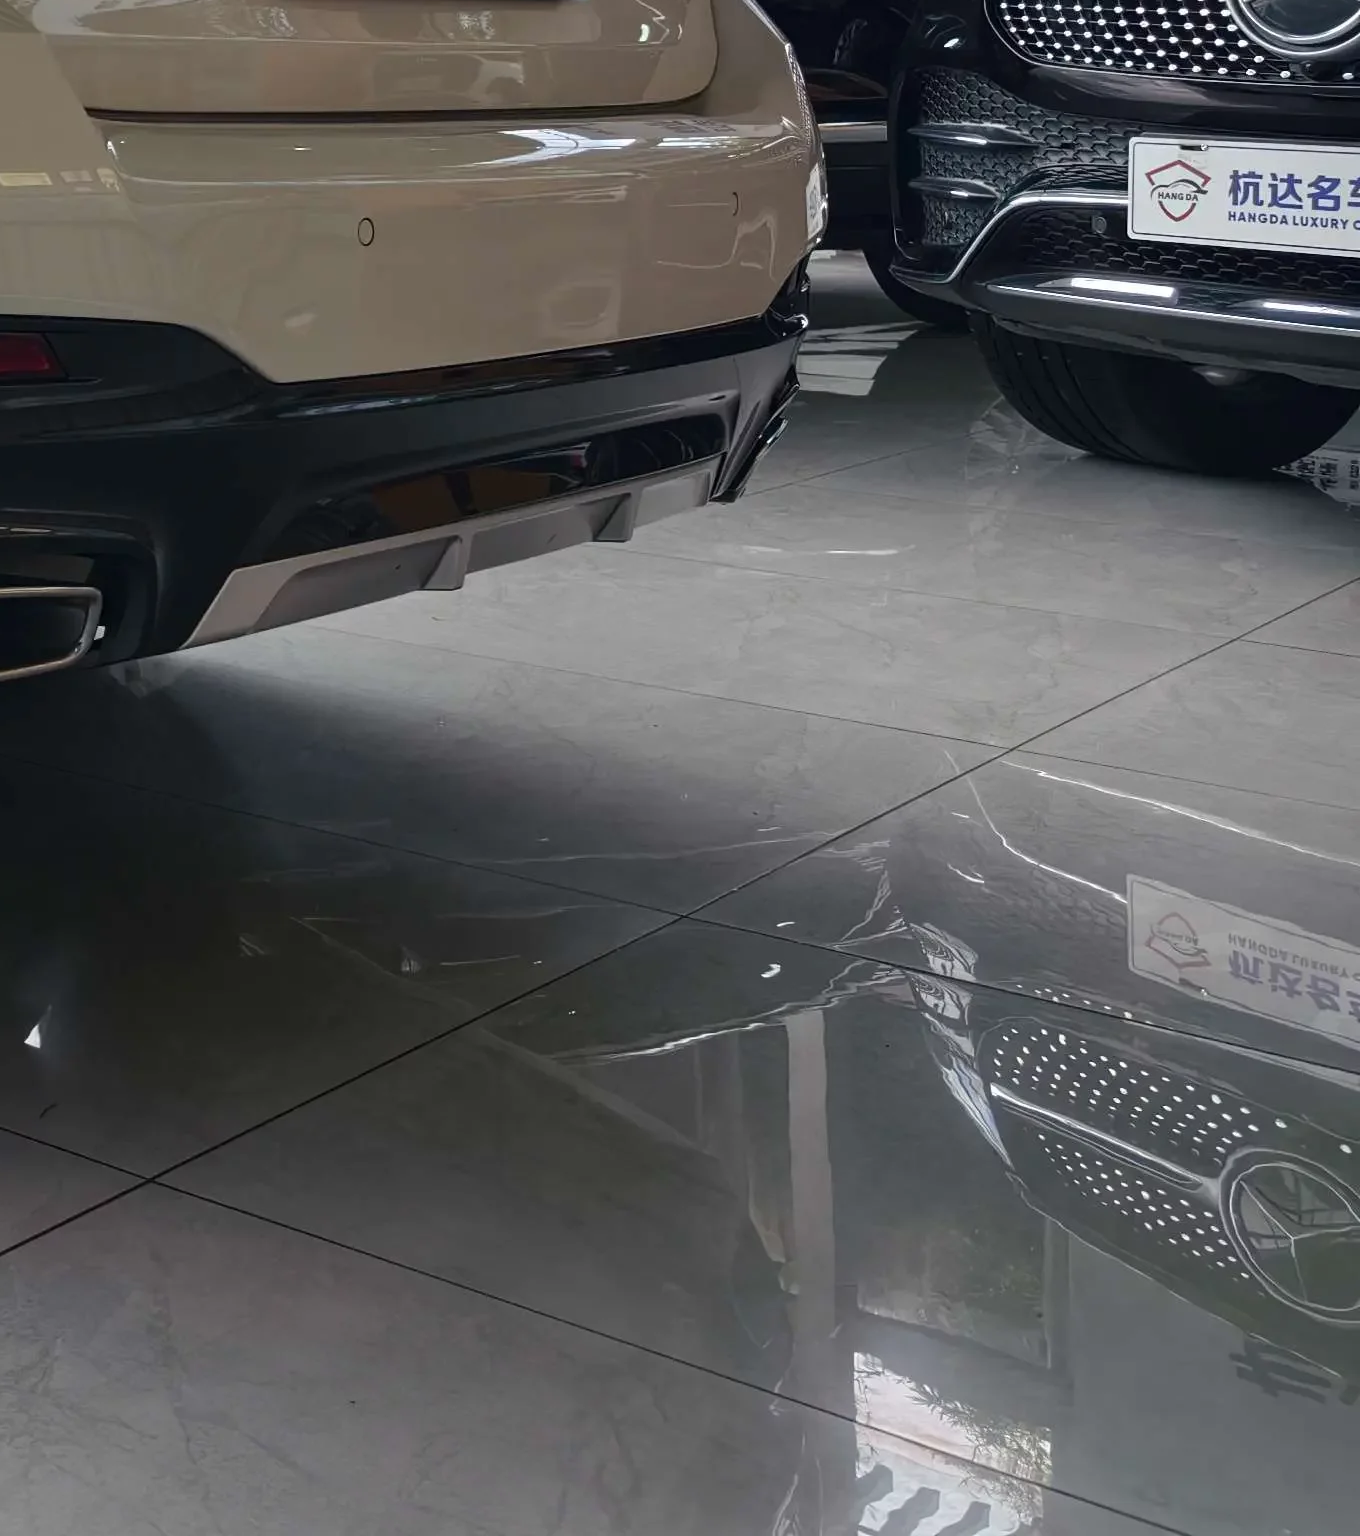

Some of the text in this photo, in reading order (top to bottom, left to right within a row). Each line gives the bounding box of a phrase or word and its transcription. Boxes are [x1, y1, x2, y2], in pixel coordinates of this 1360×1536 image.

[1158, 191, 1199, 202] HANG DA
[1228, 211, 1288, 226] HANGDA
[1292, 215, 1349, 231] LUXURY
